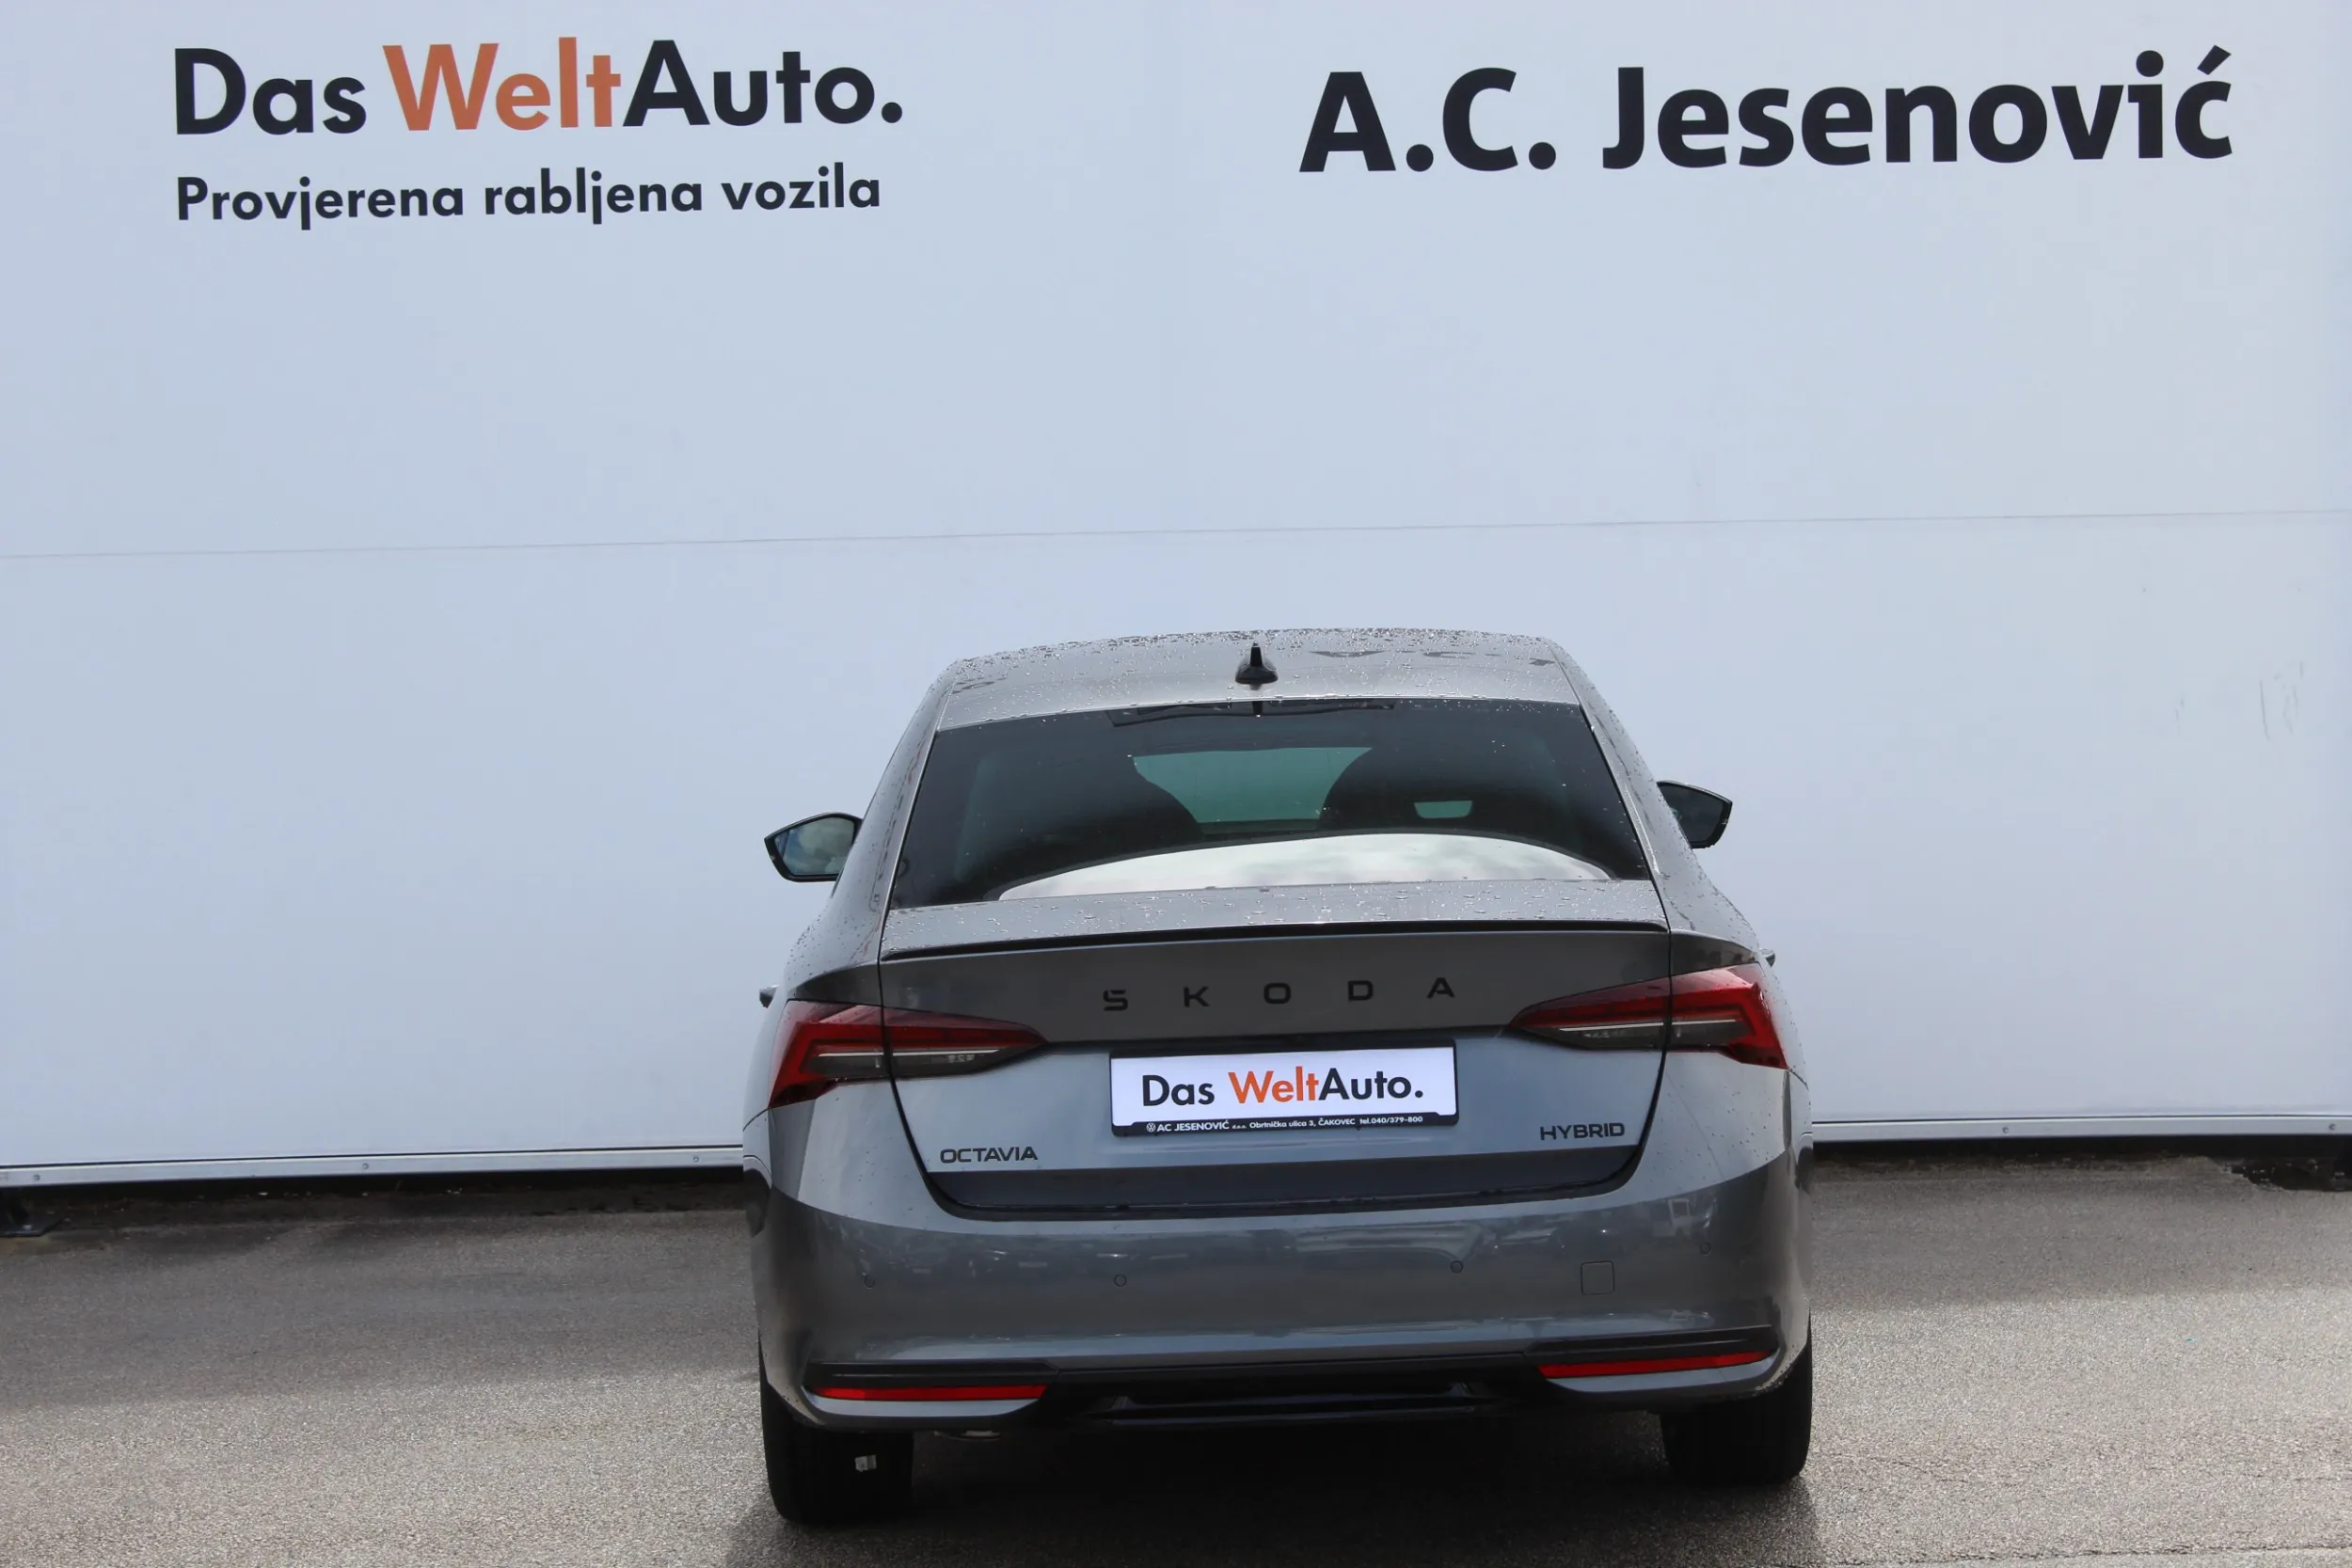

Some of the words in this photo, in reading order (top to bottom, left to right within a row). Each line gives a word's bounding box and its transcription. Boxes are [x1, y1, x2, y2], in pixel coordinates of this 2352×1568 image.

[175, 48, 366, 135] Das
[383, 36, 903, 132] WeltAuto.
[1299, 67, 1557, 172] A.C.
[1603, 44, 2233, 170] Jesenović
[177, 176, 464, 231] Provjerena
[485, 167, 703, 226] rabljena
[721, 161, 881, 211] vozila
[1142, 1074, 1216, 1107] Das
[1228, 1066, 1424, 1104] WeltAuto.
[1156, 1123, 1172, 1132] AC
[1174, 1119, 1230, 1132] JESENOVIĆ
[1249, 1120, 1287, 1129] Obrtnička
[1318, 1117, 1356, 1126] ČAKOVEC
[1540, 1122, 1626, 1141] HYBRID
[940, 1146, 1039, 1164] OCTAVIA
